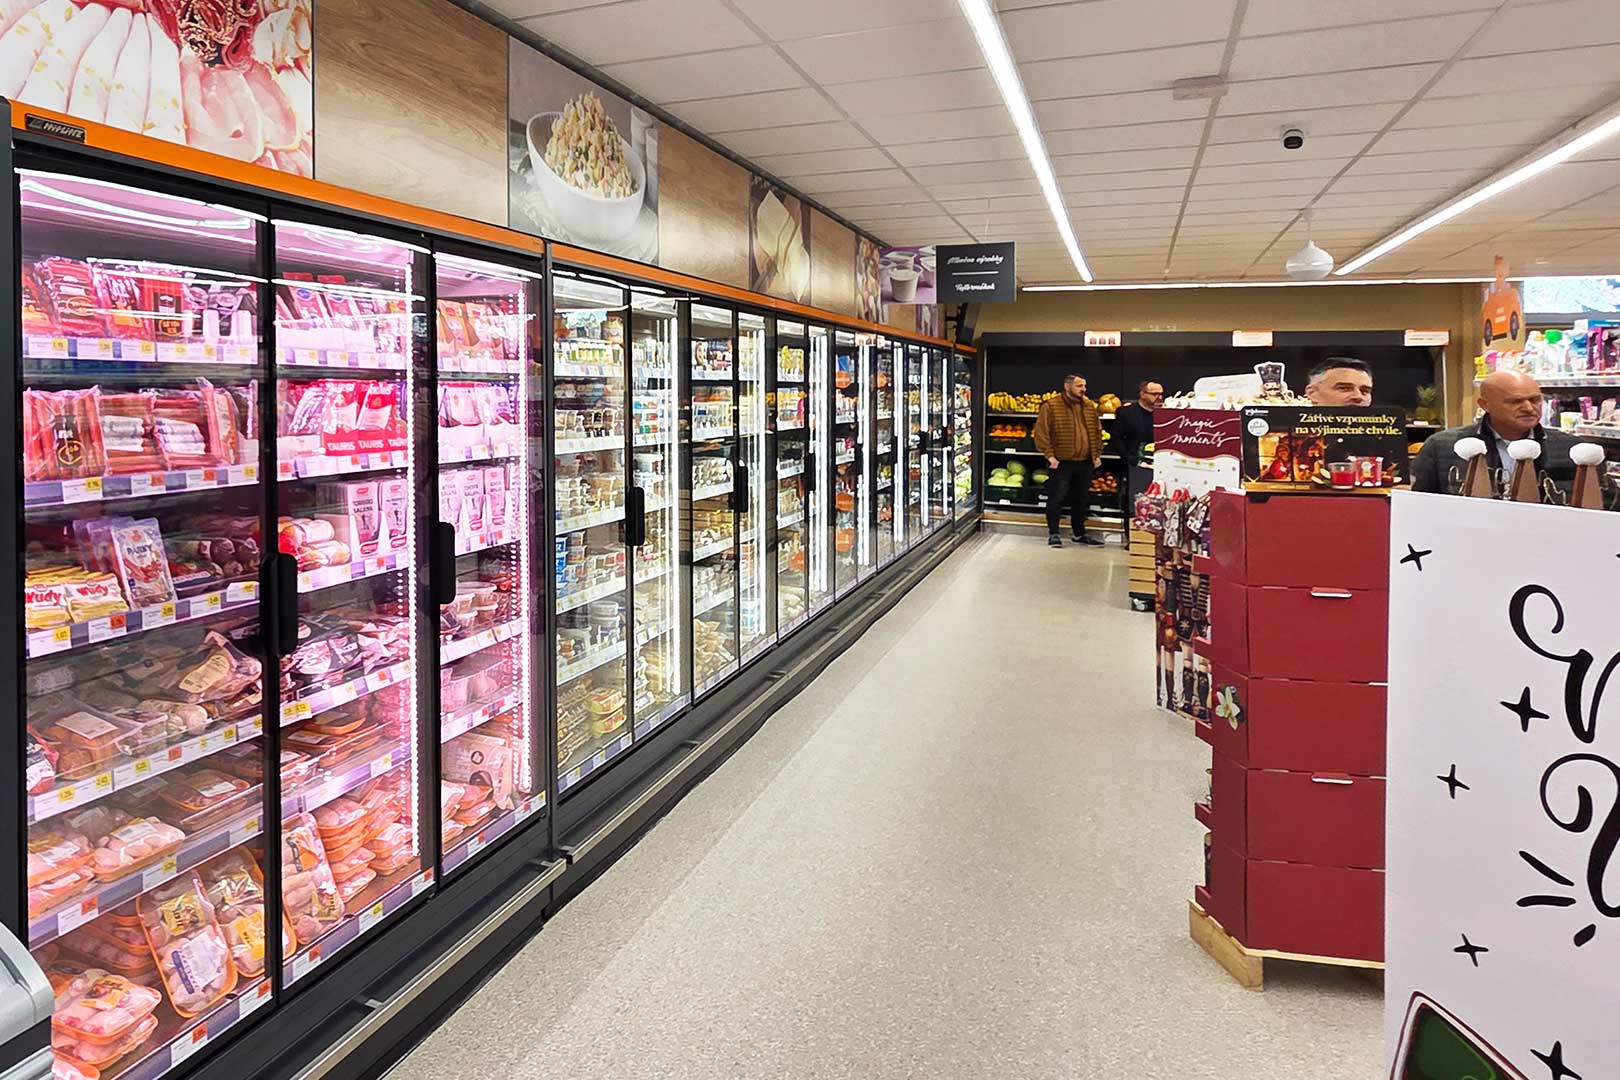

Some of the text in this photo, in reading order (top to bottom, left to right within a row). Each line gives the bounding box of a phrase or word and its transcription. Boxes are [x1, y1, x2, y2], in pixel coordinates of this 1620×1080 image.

[327, 441, 356, 451] TAURIS
[358, 439, 385, 448] TAURIS
[76, 584, 109, 596] Wudy
